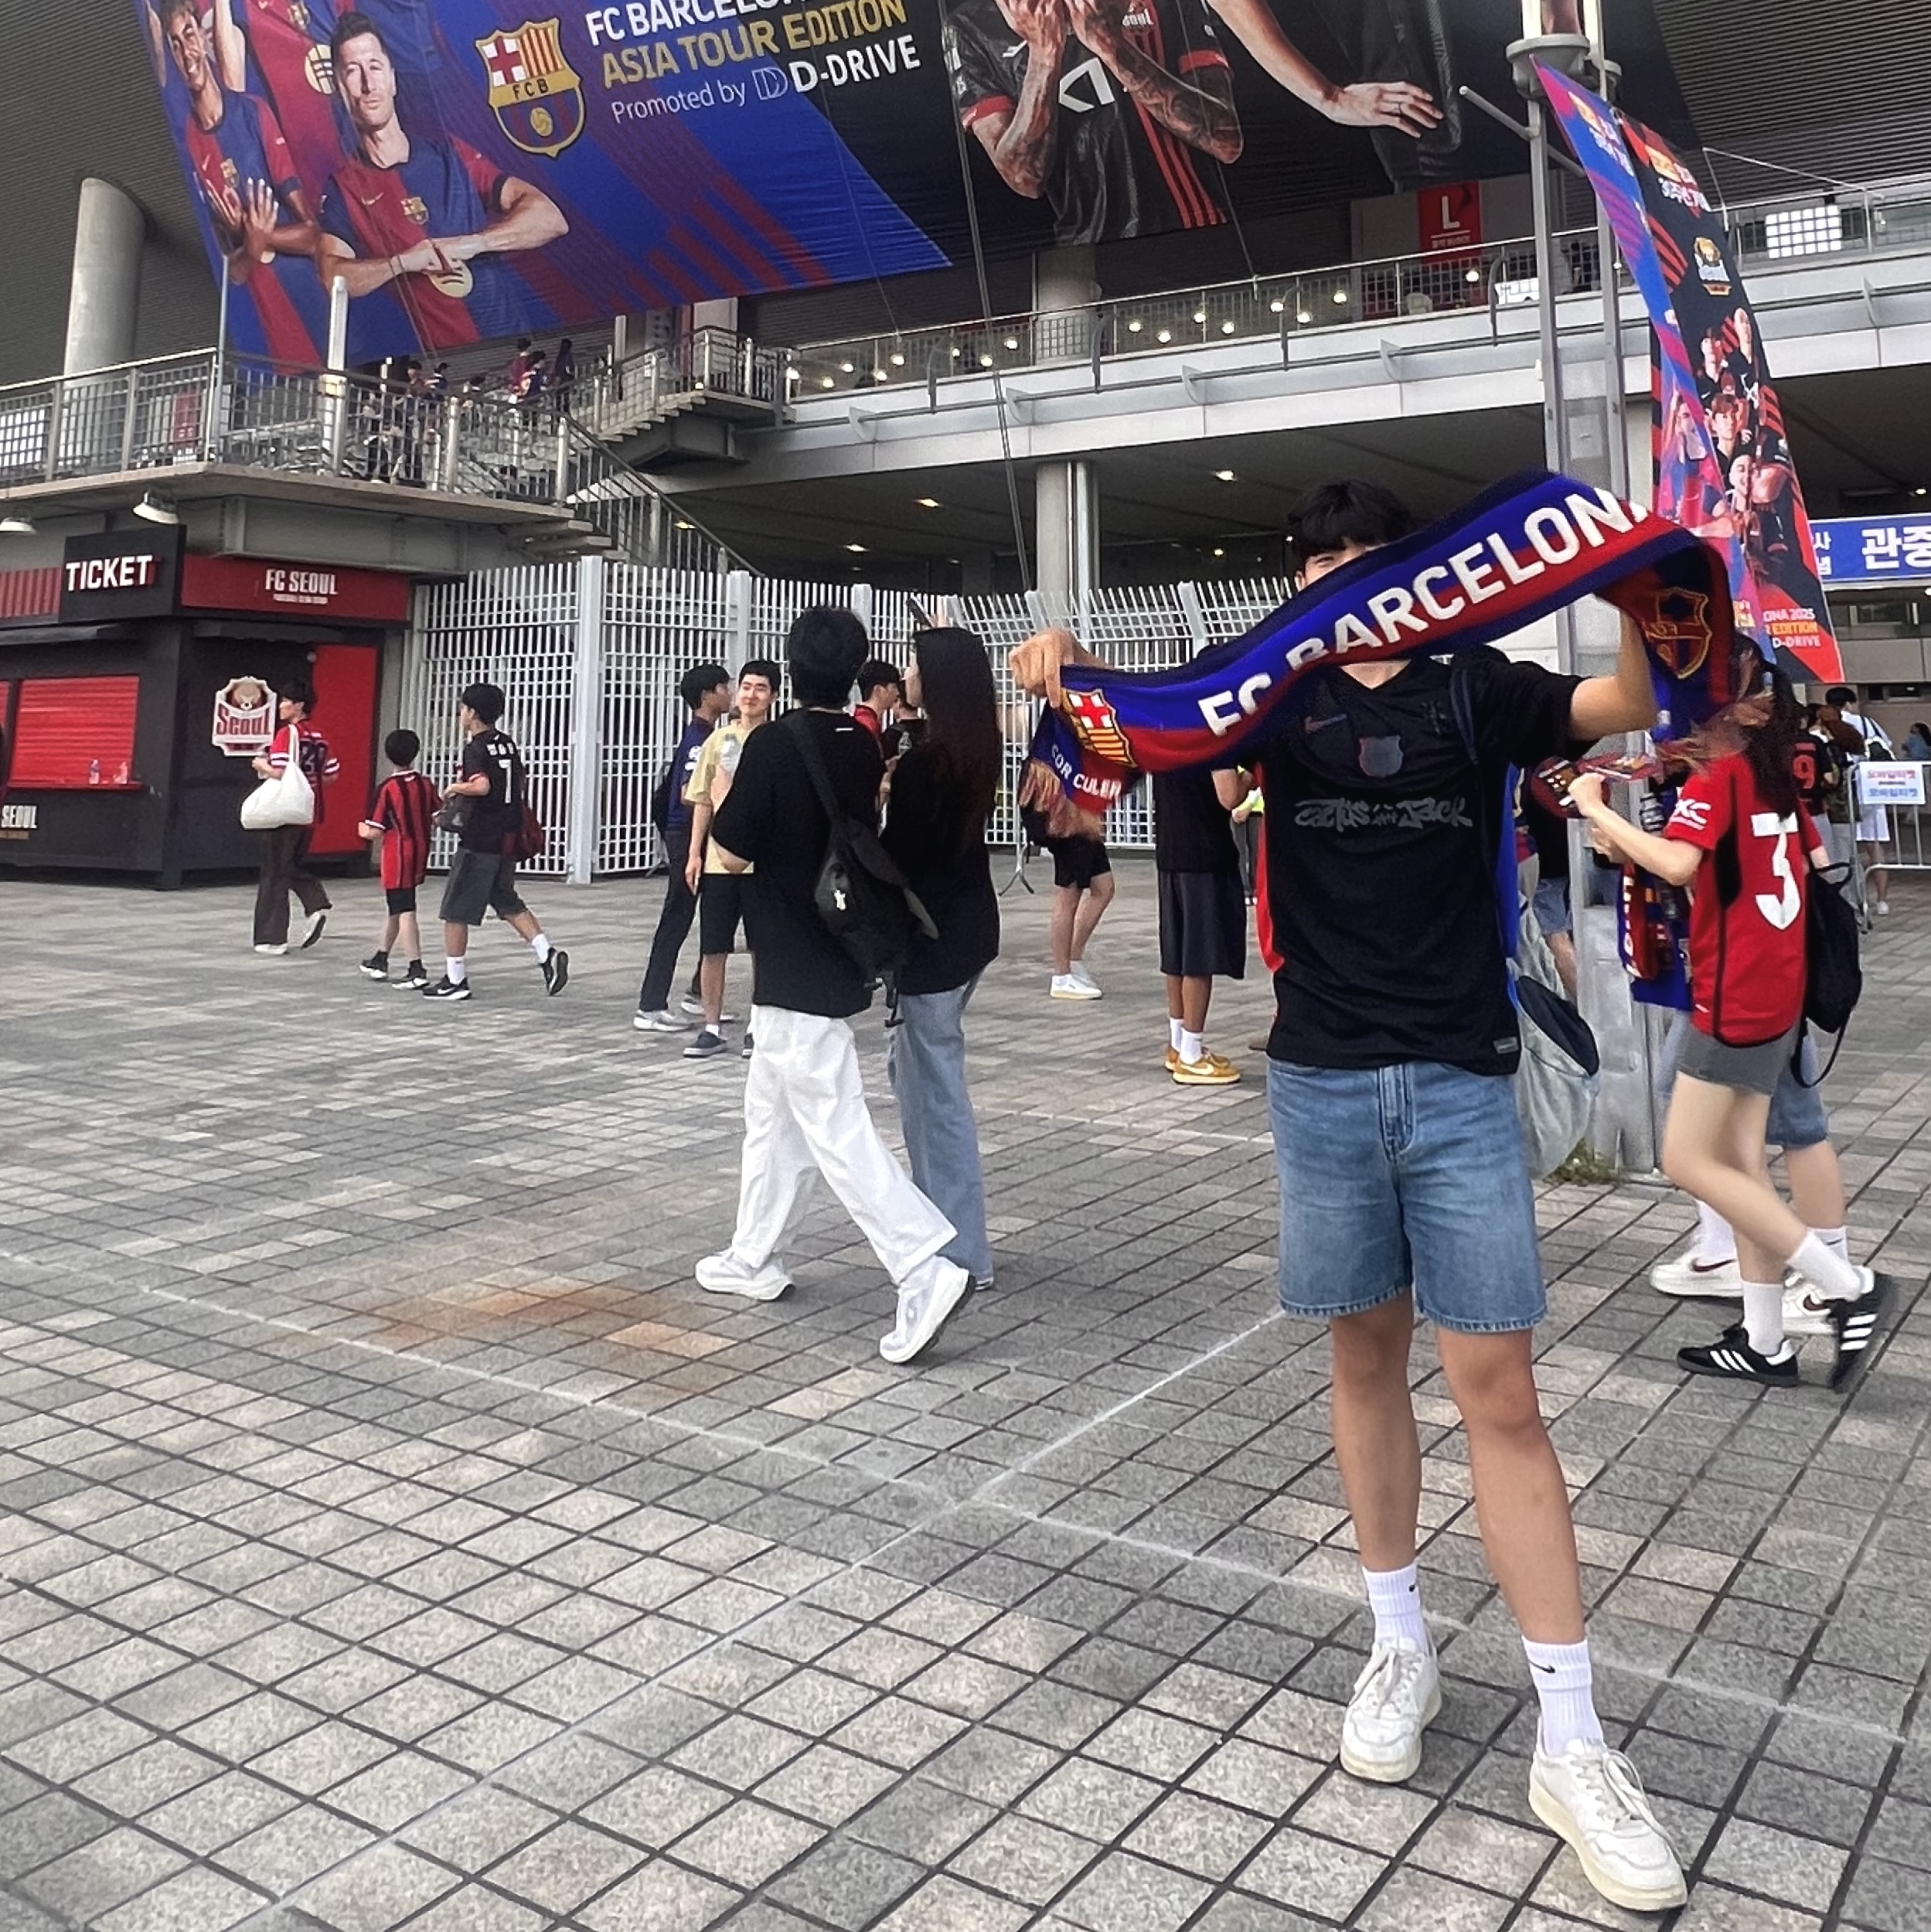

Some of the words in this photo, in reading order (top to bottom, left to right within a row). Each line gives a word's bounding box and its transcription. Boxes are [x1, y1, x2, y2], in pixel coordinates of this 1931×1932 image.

[585, 6, 626, 46] FC
[603, 42, 681, 89] ASIA
[677, 20, 781, 71] TOUR
[782, 0, 908, 50] EDITION
[512, 78, 549, 100] FCB
[611, 80, 716, 124] Promoted
[717, 79, 746, 107] by
[788, 34, 921, 93] D-DRIVE
[1442, 196, 1460, 230] L
[66, 554, 154, 591] TICKET
[265, 569, 285, 591] FC
[288, 571, 339, 595] SEOUL
[1285, 487, 1649, 671] BARCELON
[1771, 621, 1818, 635] EDITION
[1772, 635, 1821, 649] D-DRIVE
[216, 702, 271, 735] Seoul
[1051, 743, 1073, 780] COR
[1, 805, 38, 829] SEOUL
[1673, 799, 1711, 826] XC
[1751, 812, 1801, 931] 3
